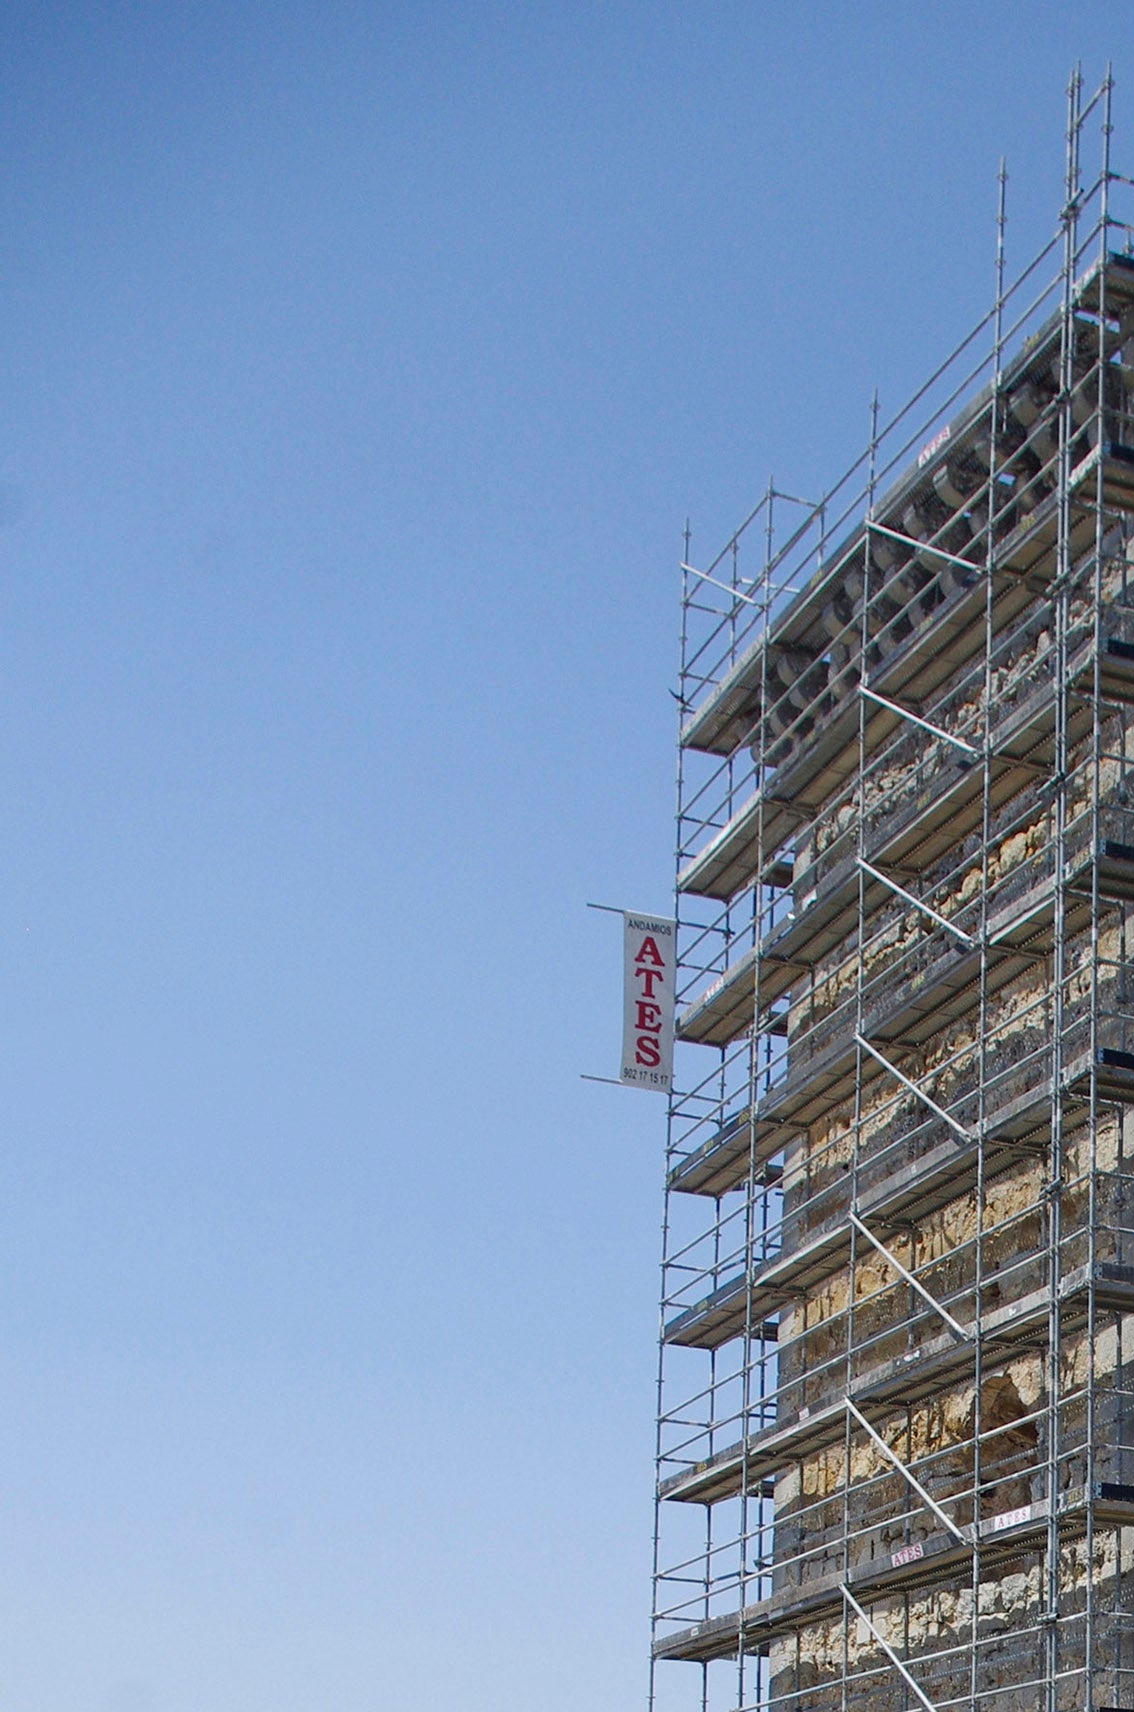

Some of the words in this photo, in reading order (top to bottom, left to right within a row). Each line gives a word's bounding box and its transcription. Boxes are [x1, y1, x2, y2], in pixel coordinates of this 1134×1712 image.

[627, 919, 672, 936] ANDAMIOS
[634, 936, 665, 1067] ATES
[623, 1067, 637, 1080] 902
[640, 1070, 648, 1081] 17
[650, 1072, 659, 1084] 15
[660, 1074, 669, 1085] 17
[998, 1509, 1026, 1528] ATES
[894, 1545, 922, 1566] ATES
